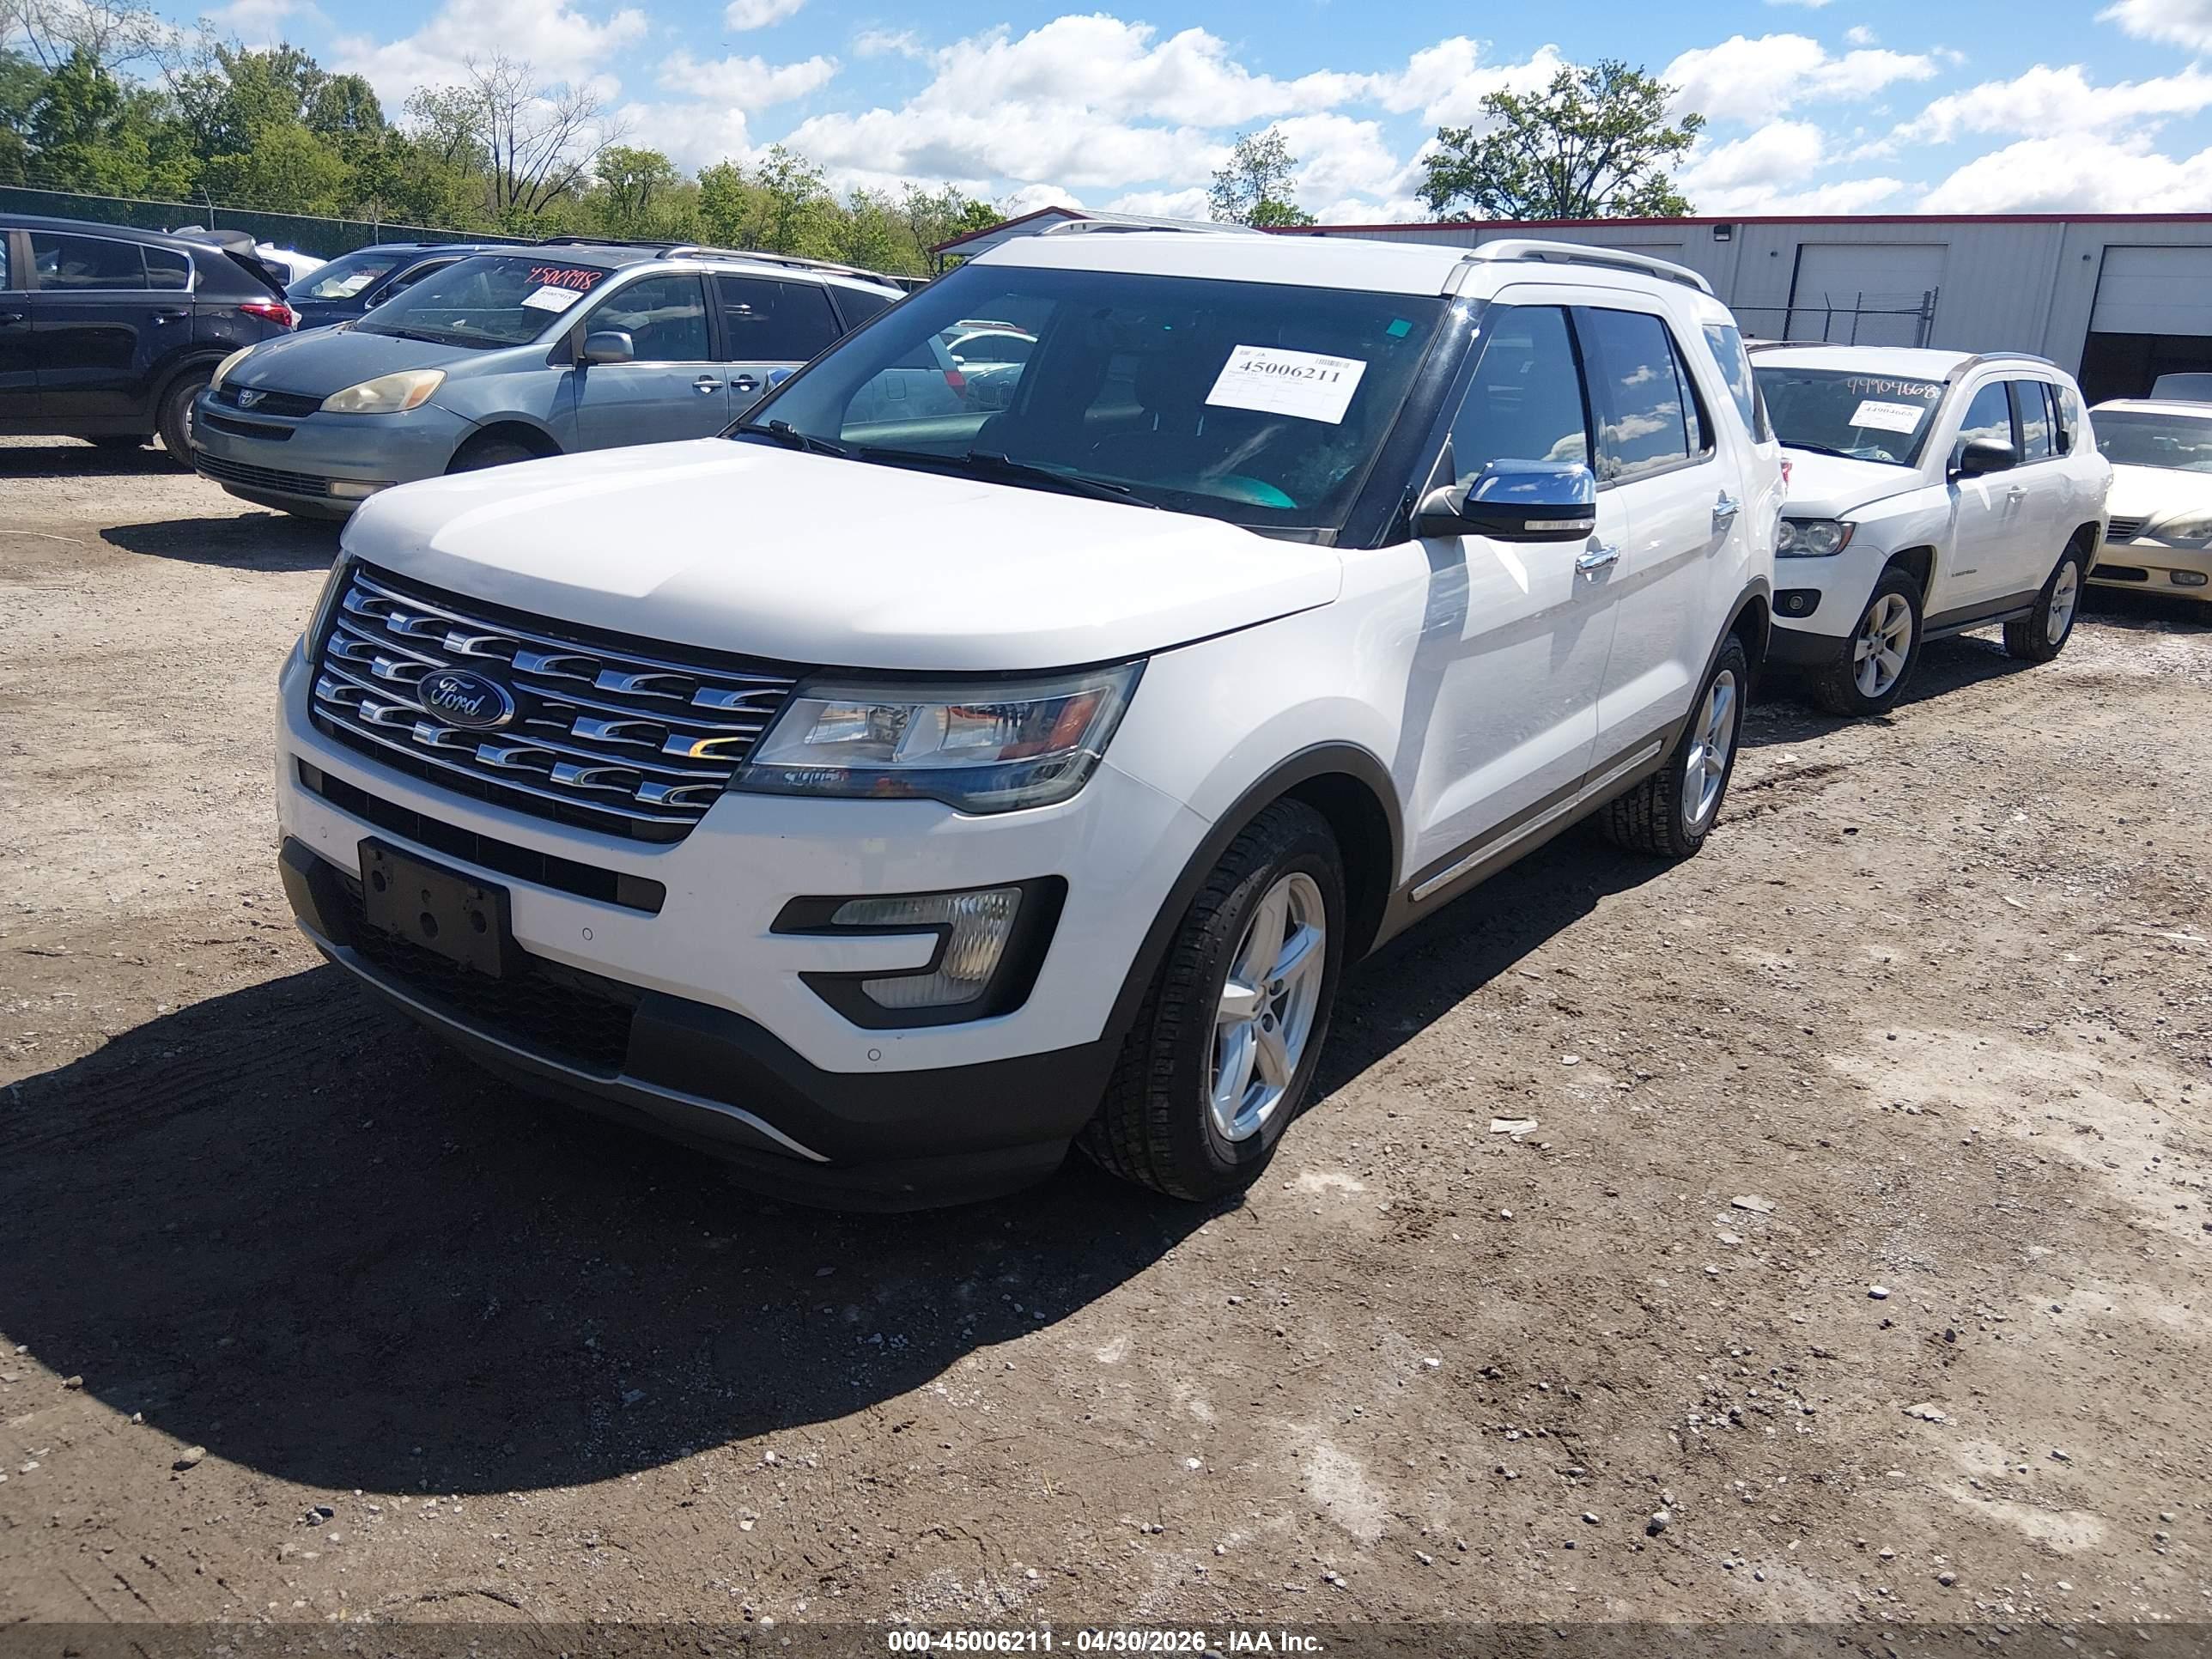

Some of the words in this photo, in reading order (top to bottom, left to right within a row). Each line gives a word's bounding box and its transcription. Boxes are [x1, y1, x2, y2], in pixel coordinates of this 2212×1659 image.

[522, 267, 603, 289] 45007918
[1238, 361, 1340, 383] 45006211
[1847, 378, 1937, 399] 44904668
[429, 676, 486, 718] Ford
